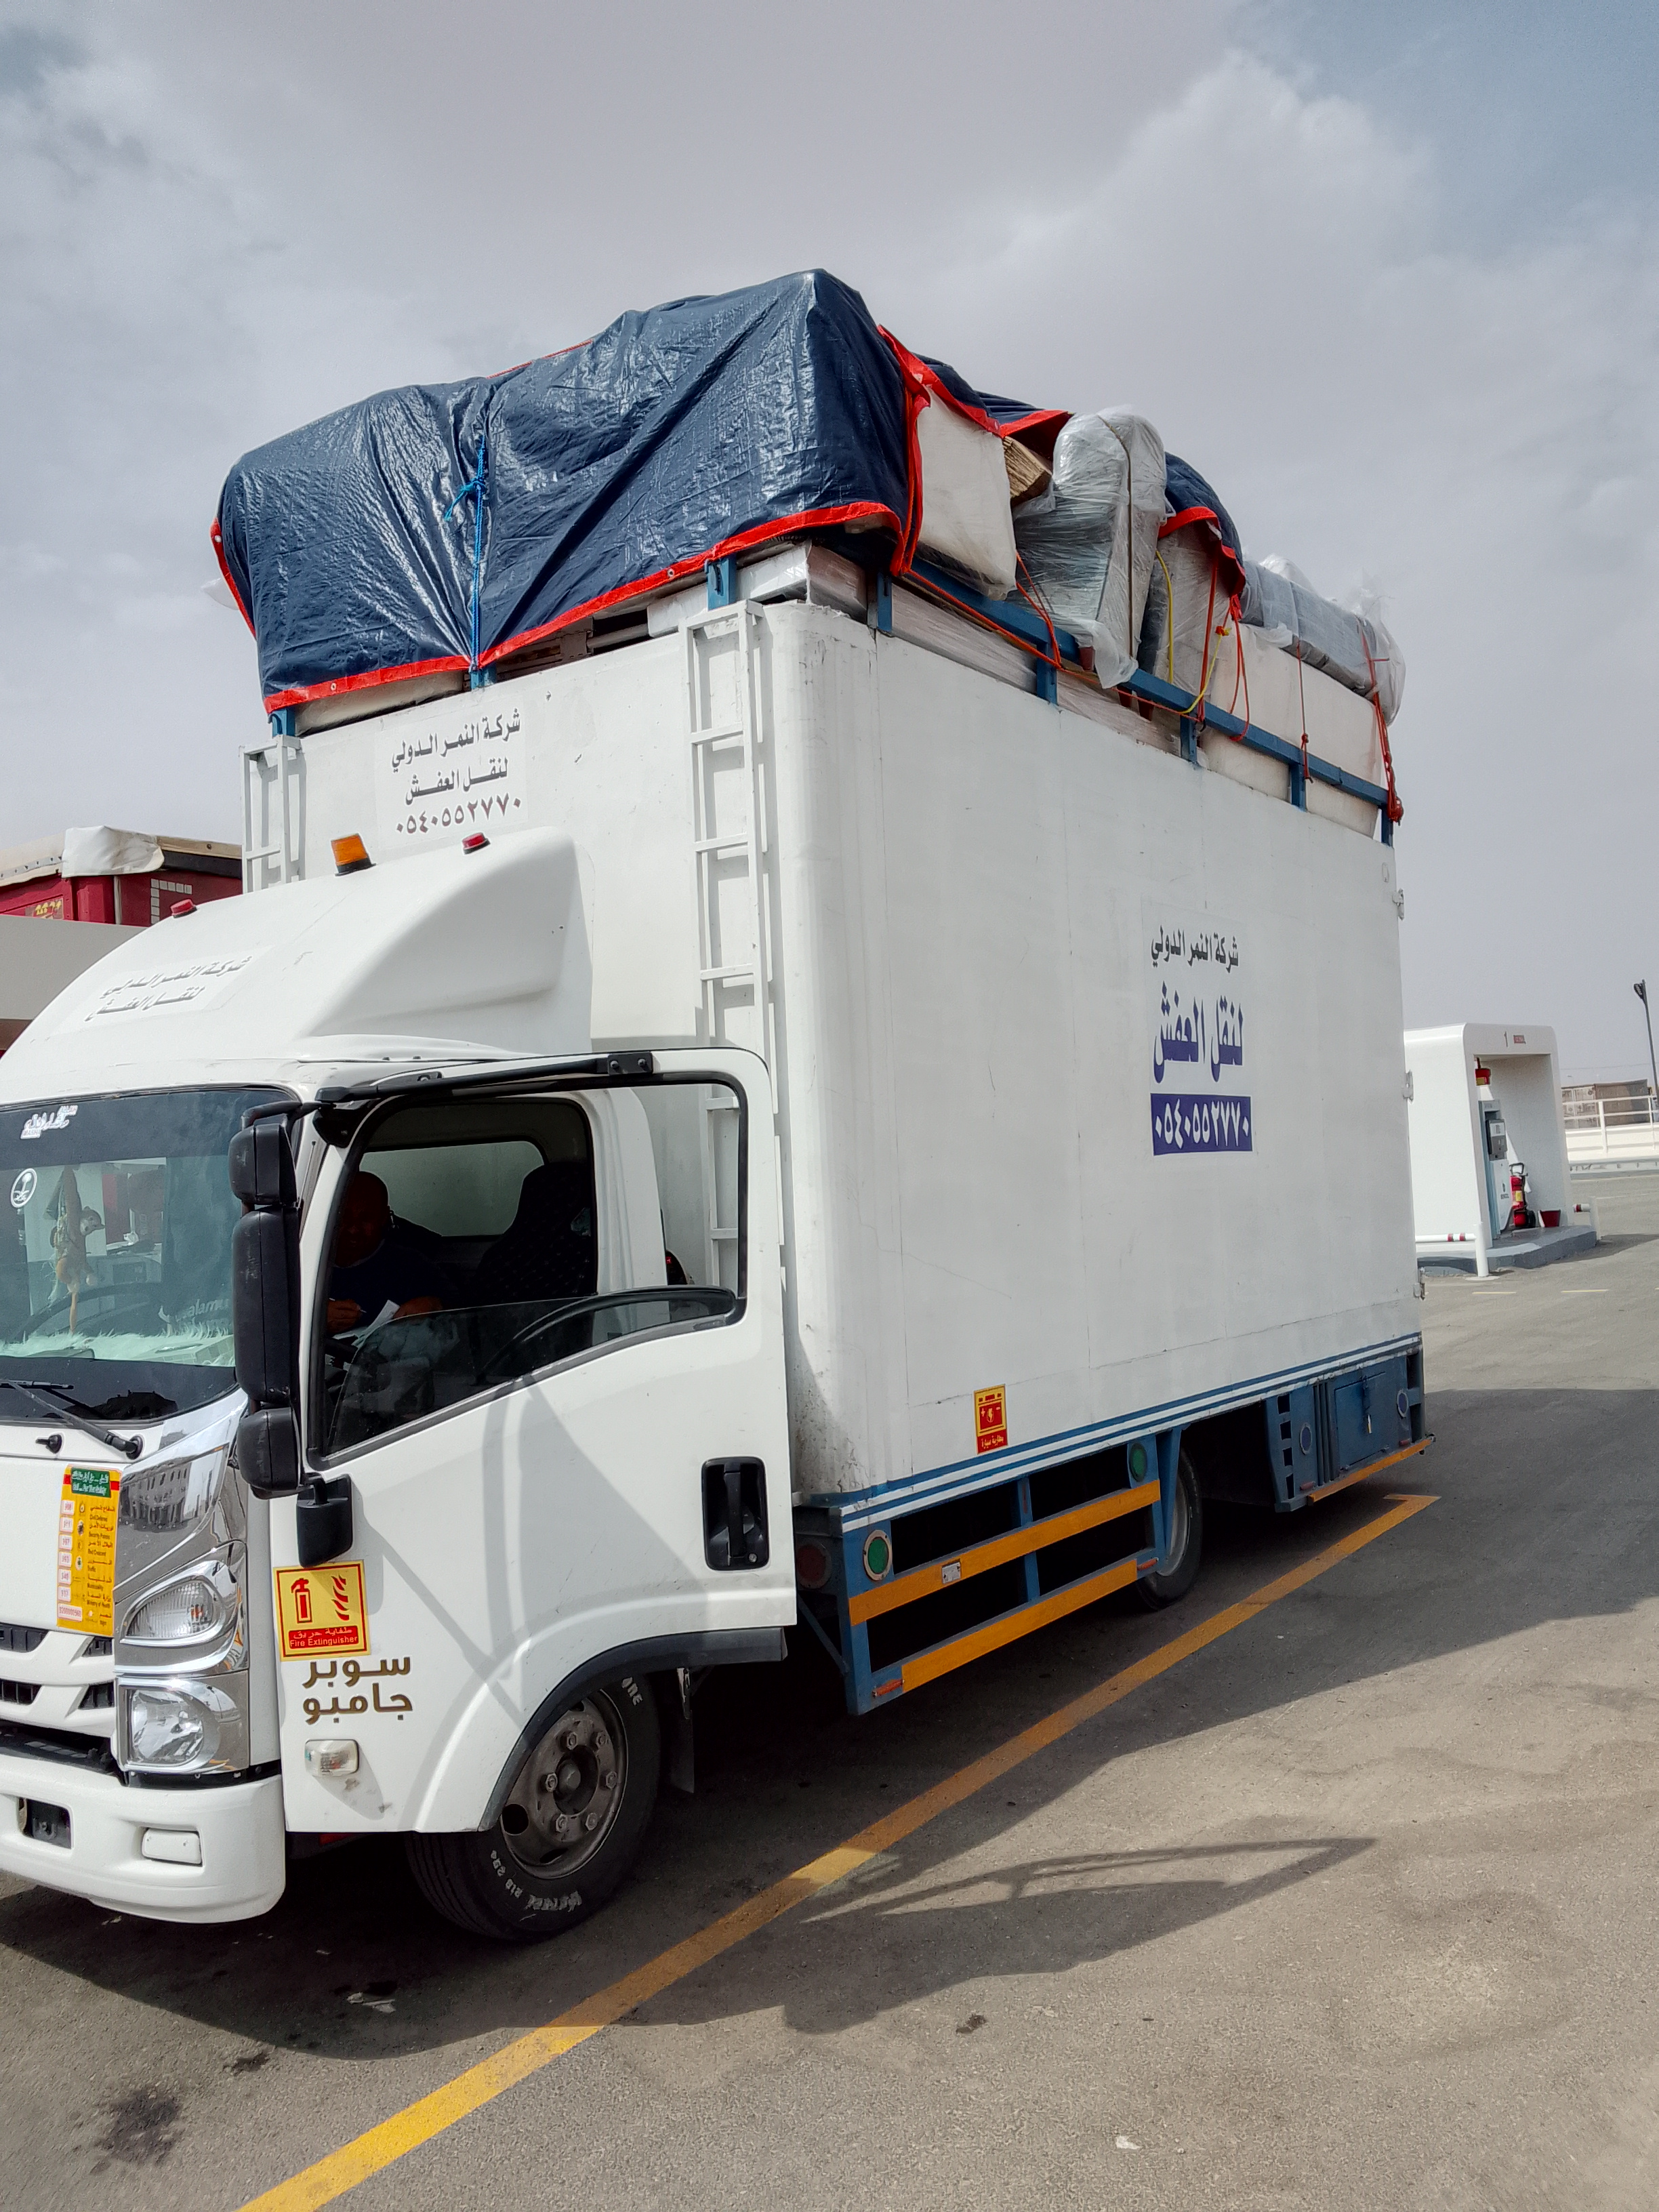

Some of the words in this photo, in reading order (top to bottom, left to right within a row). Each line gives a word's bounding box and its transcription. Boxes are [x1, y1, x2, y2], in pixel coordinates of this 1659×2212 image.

[440, 724, 480, 758] النمر
[482, 708, 521, 742] شركة
[392, 733, 438, 773] الدولي
[405, 769, 459, 805] العفش
[463, 756, 508, 792] لنقل
[1151, 924, 1185, 968] الدولي
[1187, 933, 1212, 967] النمر
[1215, 931, 1239, 973] شركة
[1153, 980, 1206, 1084] العفش
[1210, 995, 1244, 1083] لنقل
[308, 1635, 358, 1646] Extinguisher
[325, 1627, 352, 1636] طفاية
[302, 1657, 411, 1689] سوبر
[302, 1683, 413, 1725] جامبو
